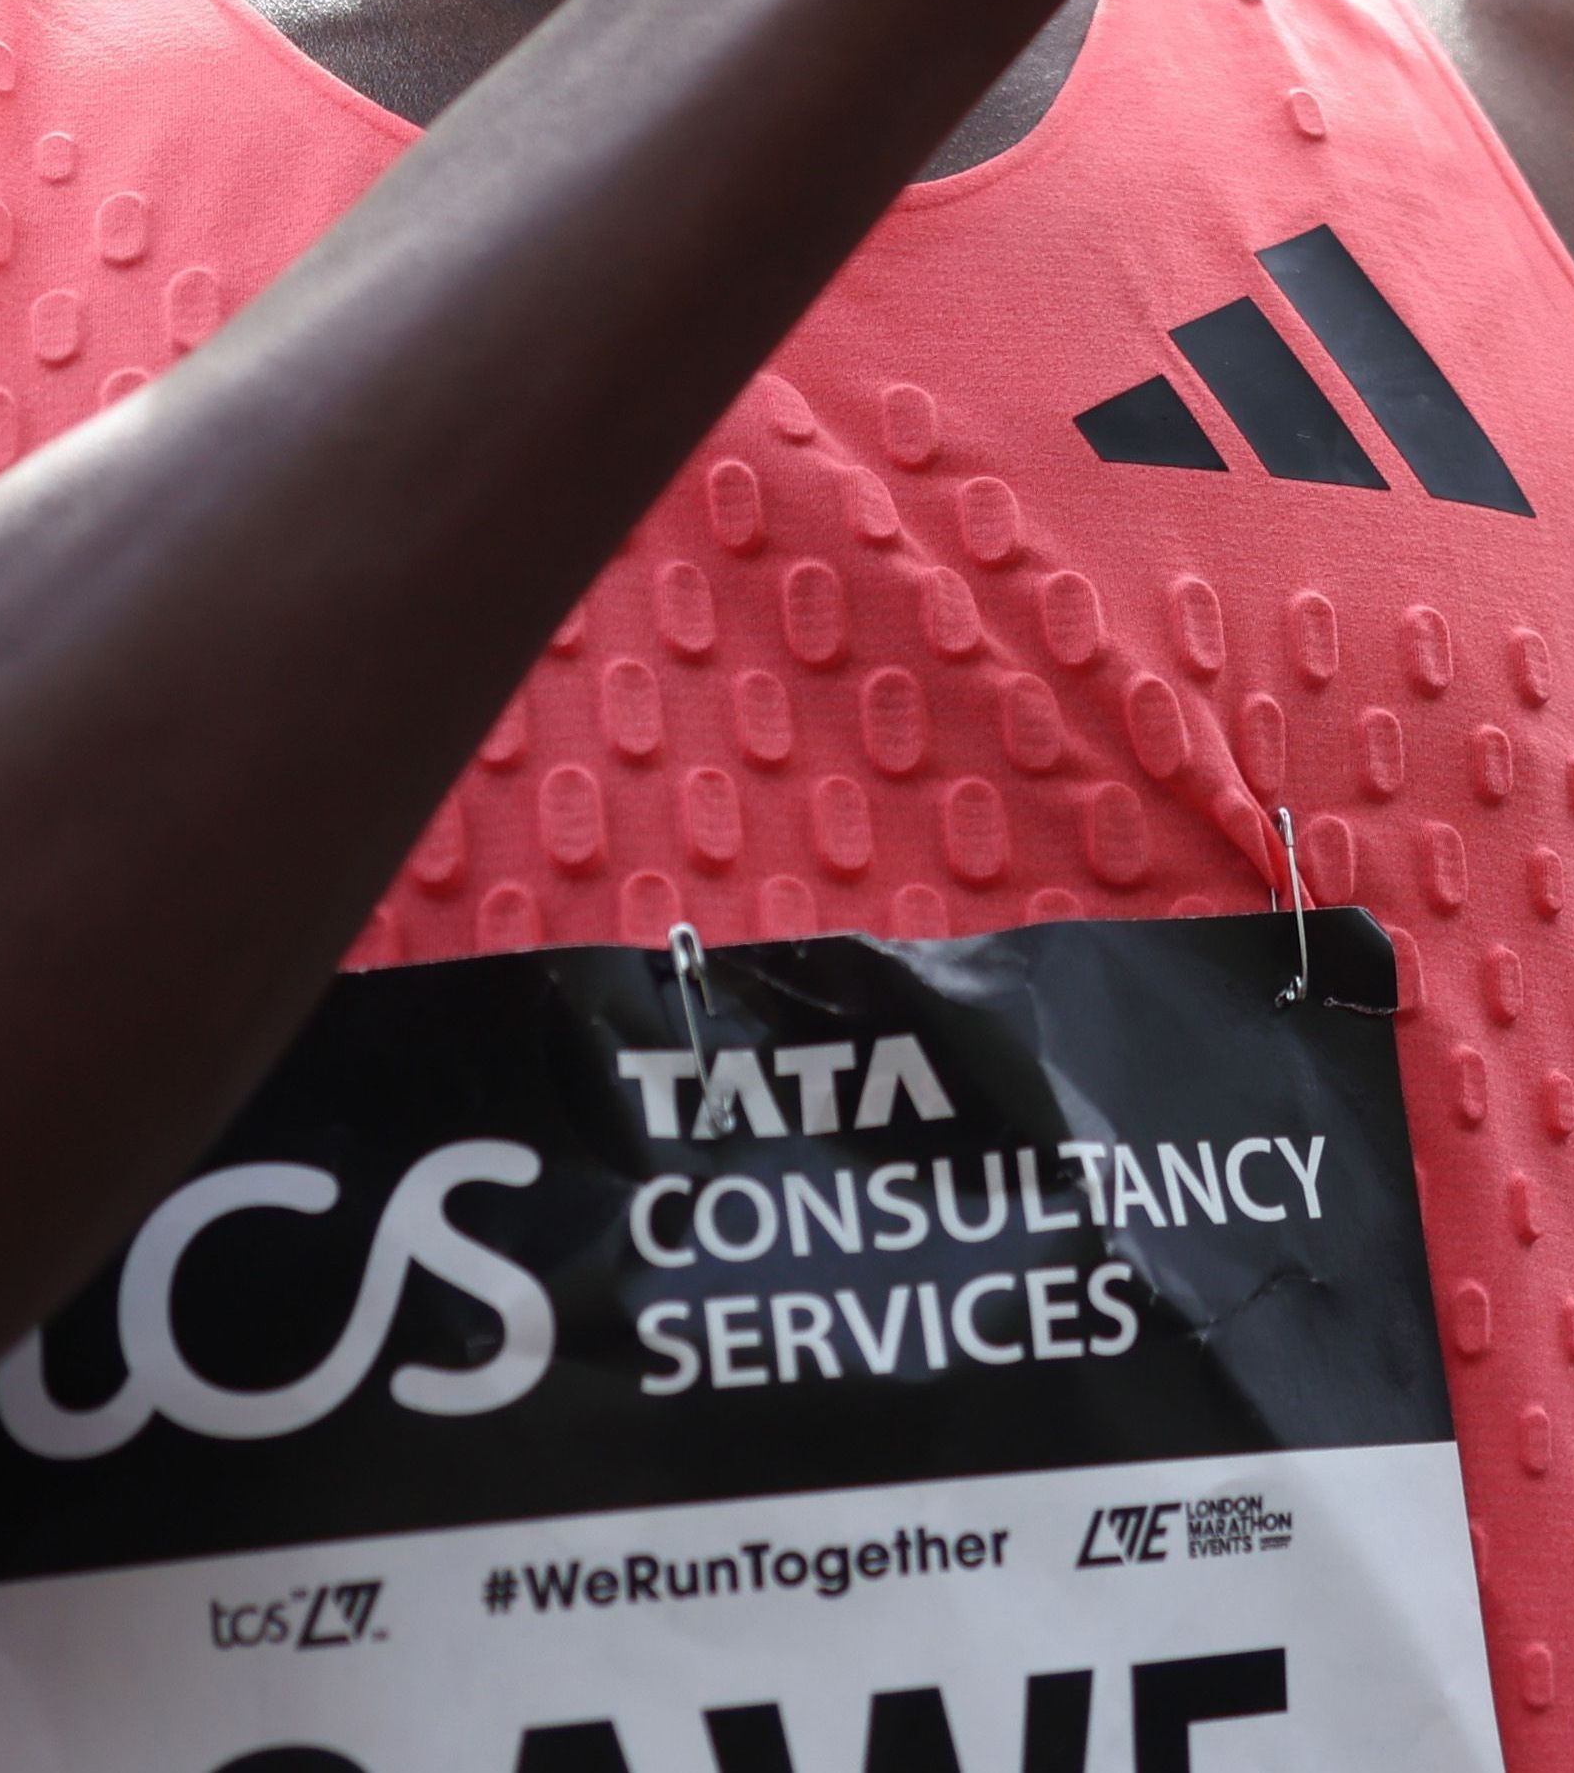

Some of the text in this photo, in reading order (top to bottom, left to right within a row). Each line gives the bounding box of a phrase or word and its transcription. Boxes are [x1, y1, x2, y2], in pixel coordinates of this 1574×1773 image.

[618, 1035, 955, 1139] TATA
[630, 1136, 1325, 1268] CONSULTANCY
[637, 1263, 1138, 1395] SERVICES
[1186, 1495, 1263, 1519] LONDON
[1188, 1512, 1292, 1539] MARATHON
[1188, 1535, 1252, 1558] EVENTS
[483, 1528, 1010, 1613] #WeRunTogether
